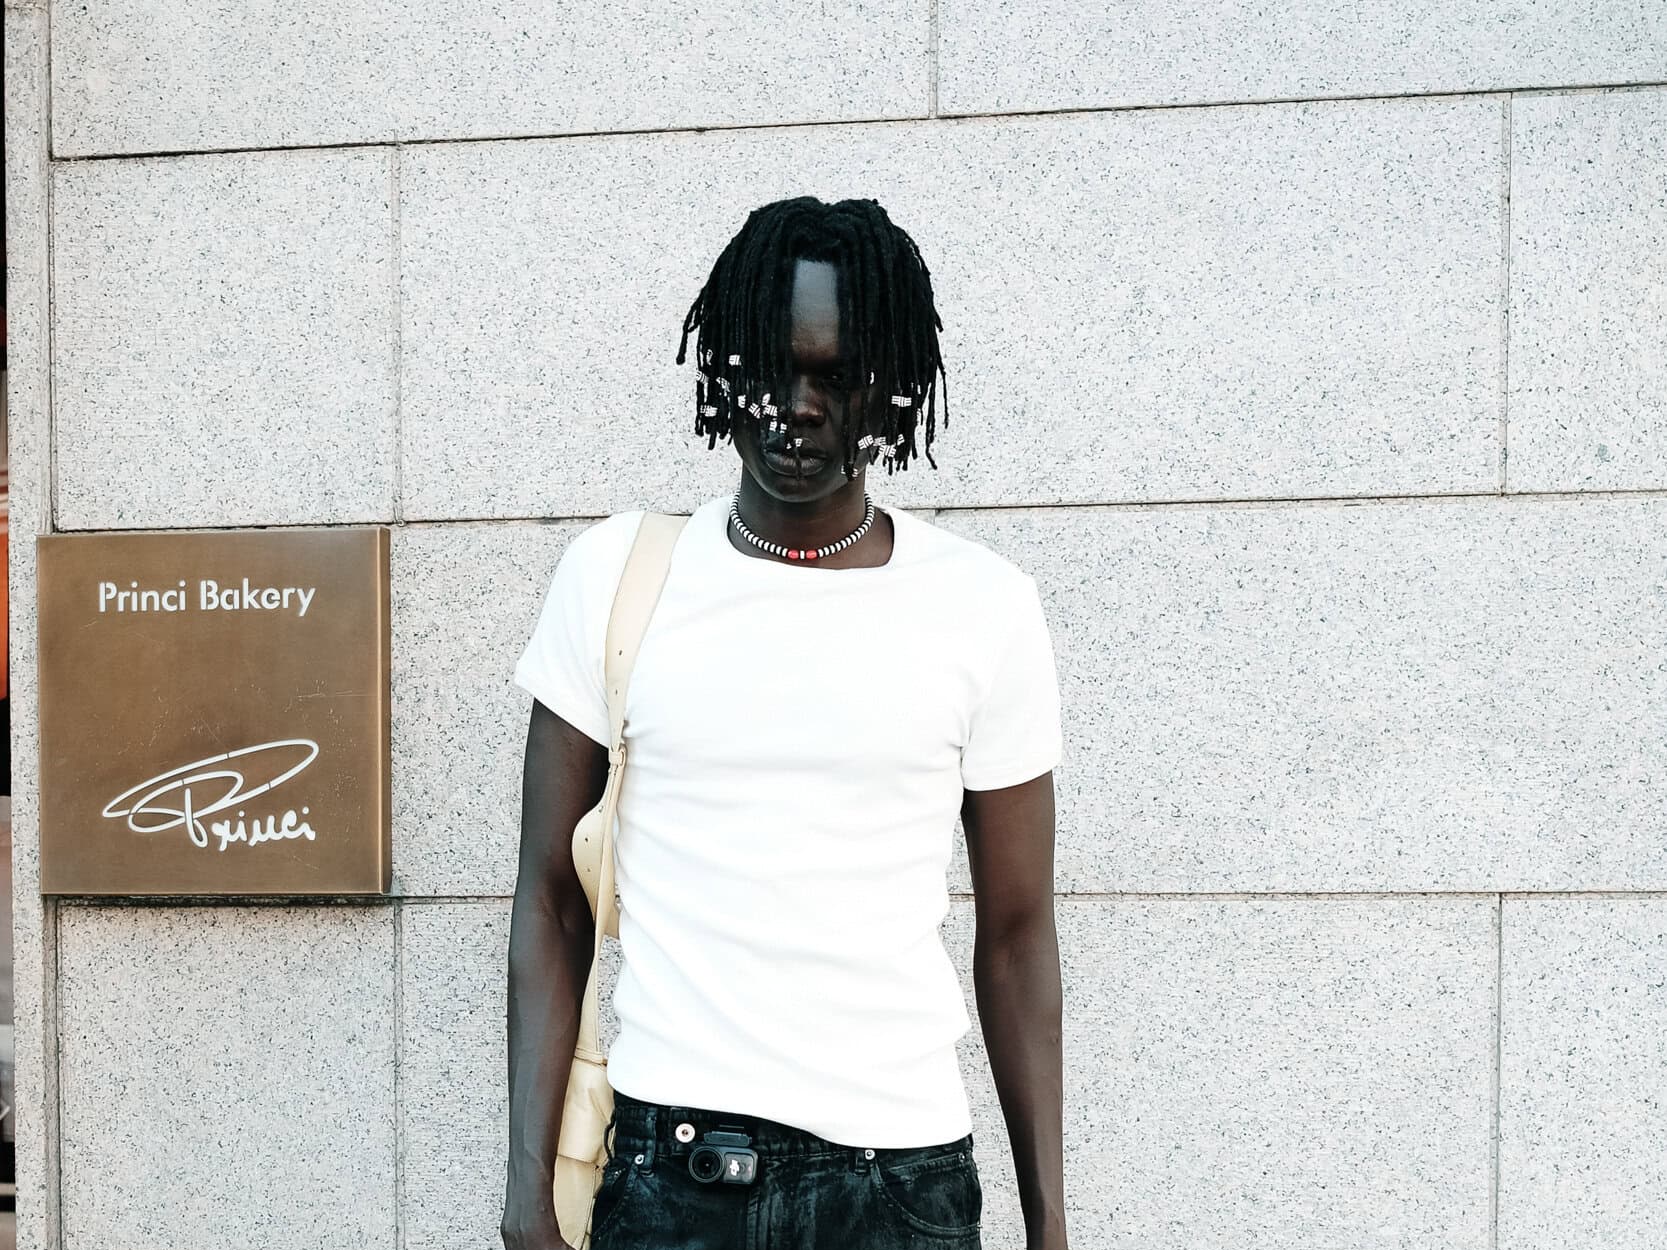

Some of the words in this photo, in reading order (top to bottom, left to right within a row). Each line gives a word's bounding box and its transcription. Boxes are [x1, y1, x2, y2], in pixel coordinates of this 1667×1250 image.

[98, 580, 187, 613] Princi
[199, 577, 316, 617] Bakery
[101, 738, 320, 852] Princi
